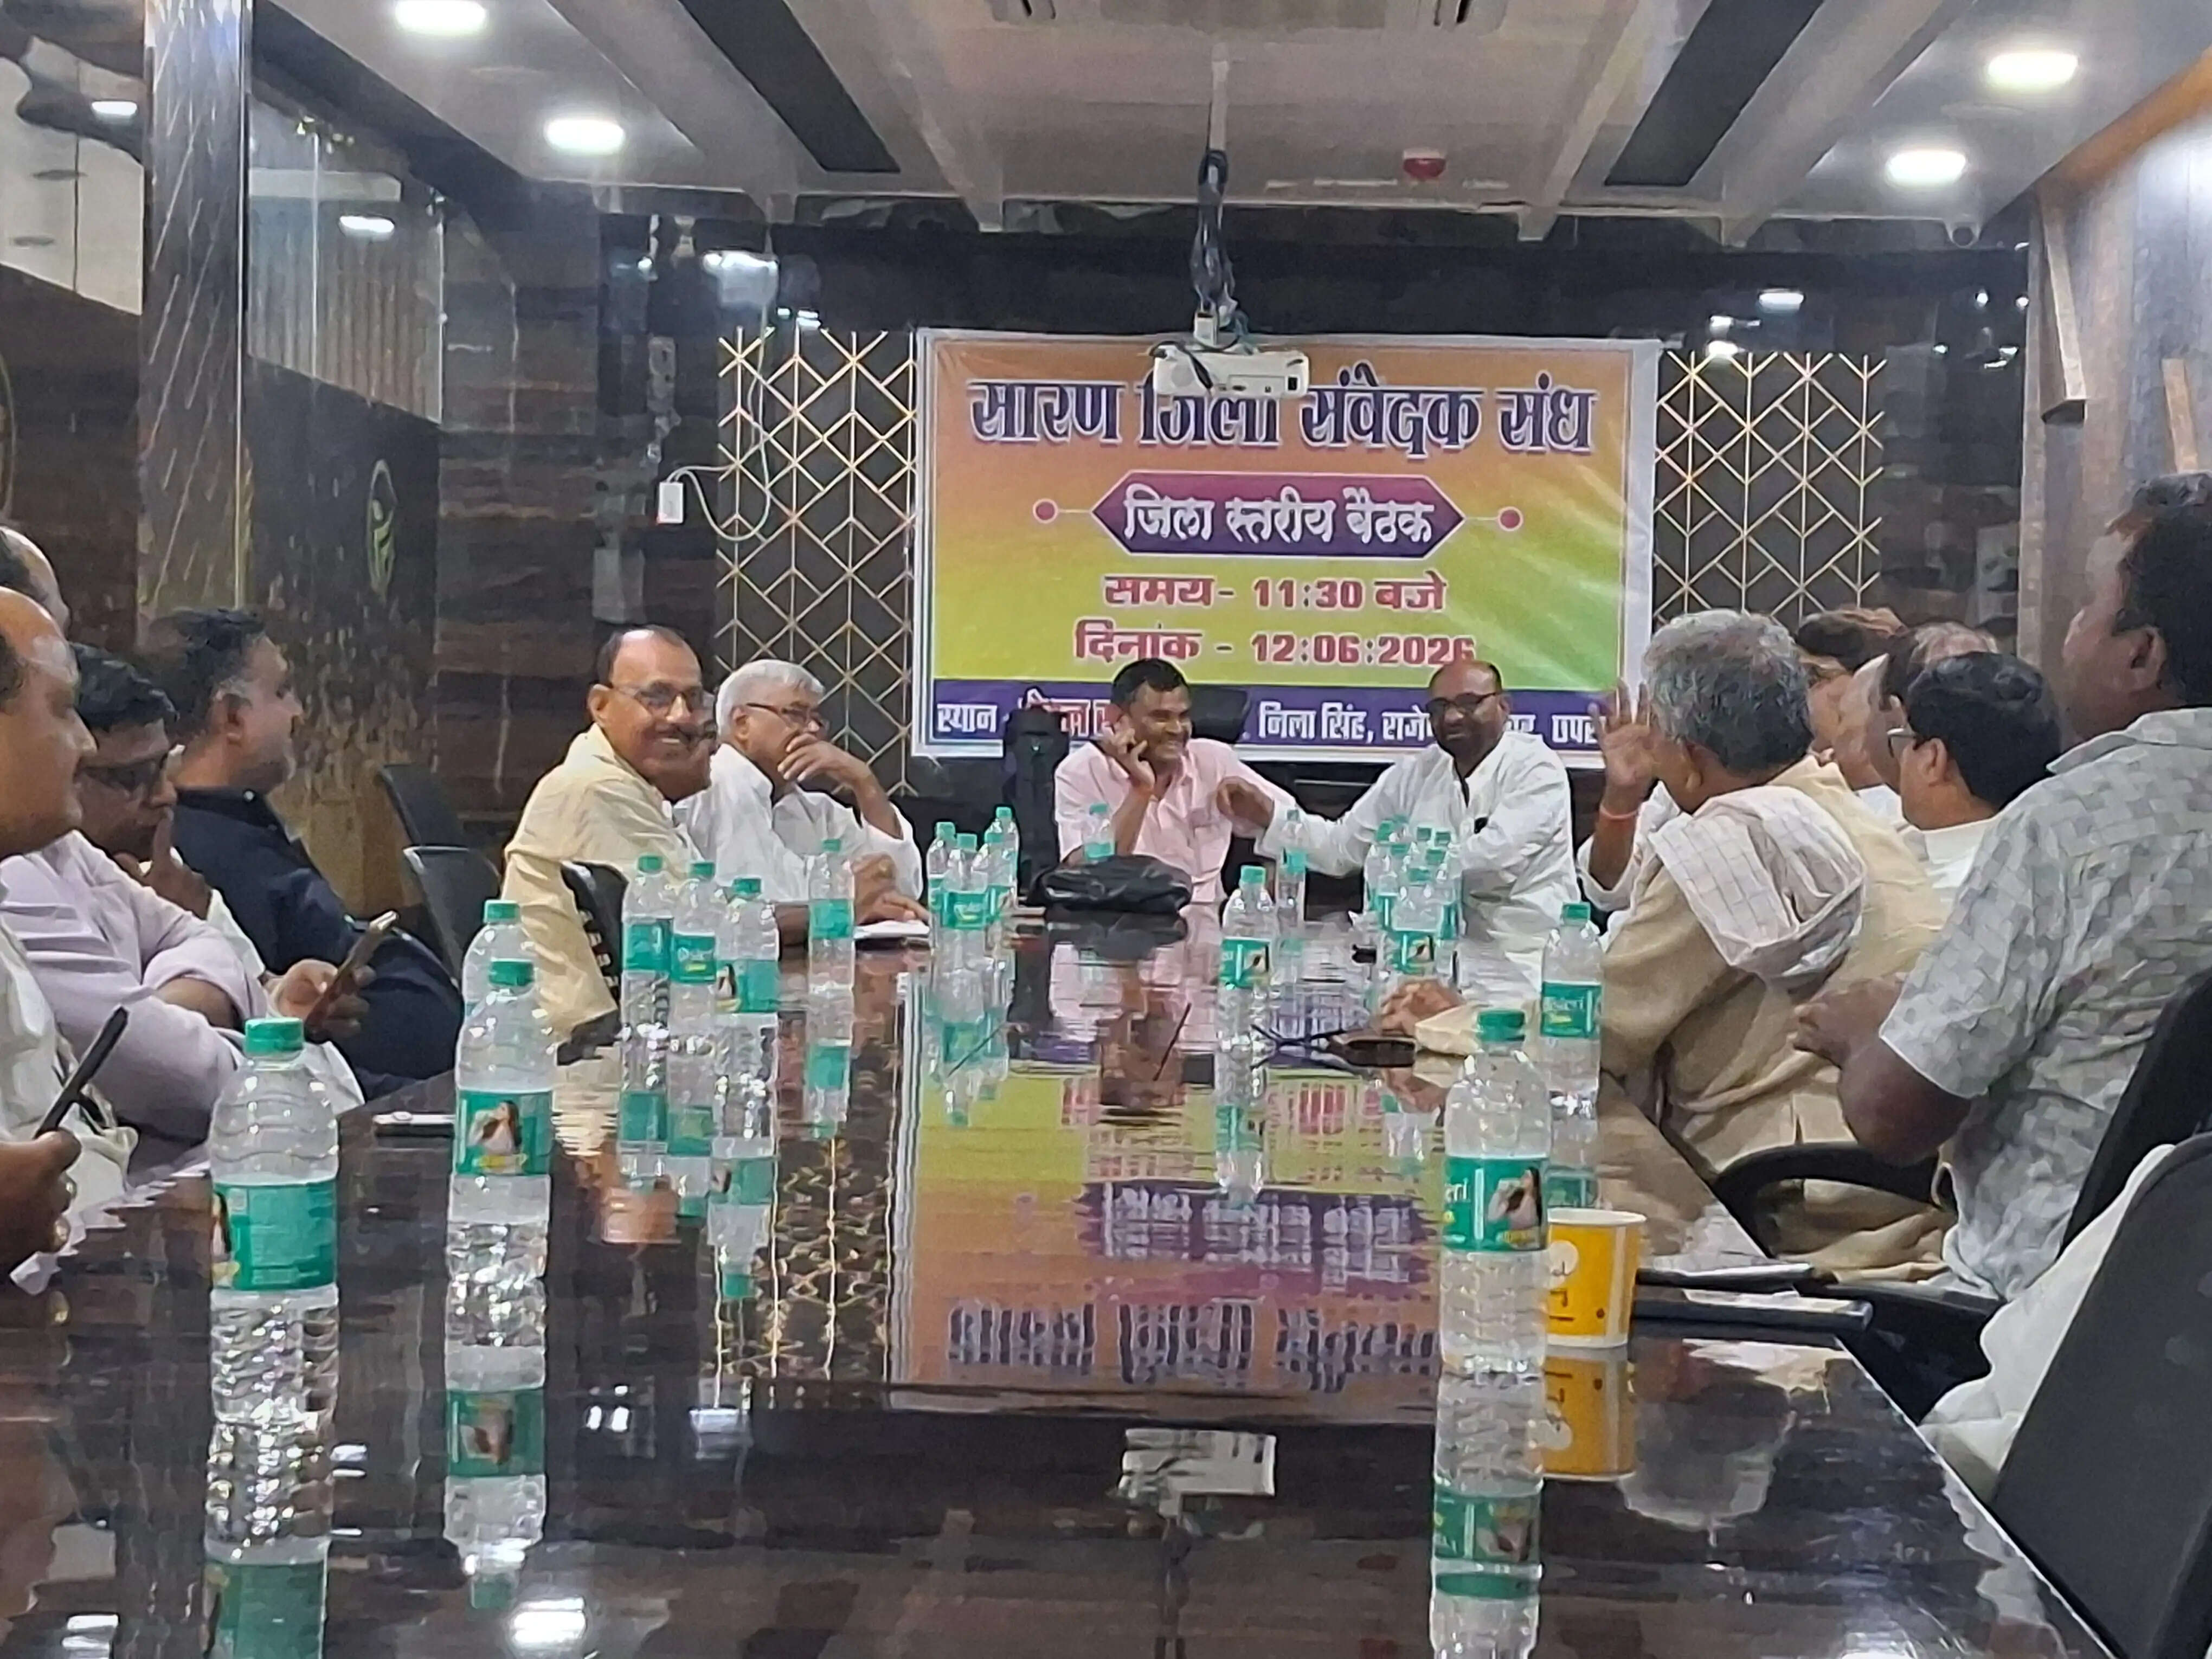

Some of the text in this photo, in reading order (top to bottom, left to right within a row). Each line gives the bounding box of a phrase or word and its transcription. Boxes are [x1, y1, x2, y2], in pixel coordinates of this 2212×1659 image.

[968, 381, 1126, 441] सारण
[1302, 361, 1484, 457] संवेदक
[1123, 483, 1435, 543] जिला स्तरीय बैठक
[1253, 579, 1363, 609] 11:30
[1374, 569, 1448, 610] बजे
[1075, 619, 1203, 663] दिनांक
[1251, 633, 1475, 666] 12:06:2026
[1381, 704, 1435, 742] राजे
